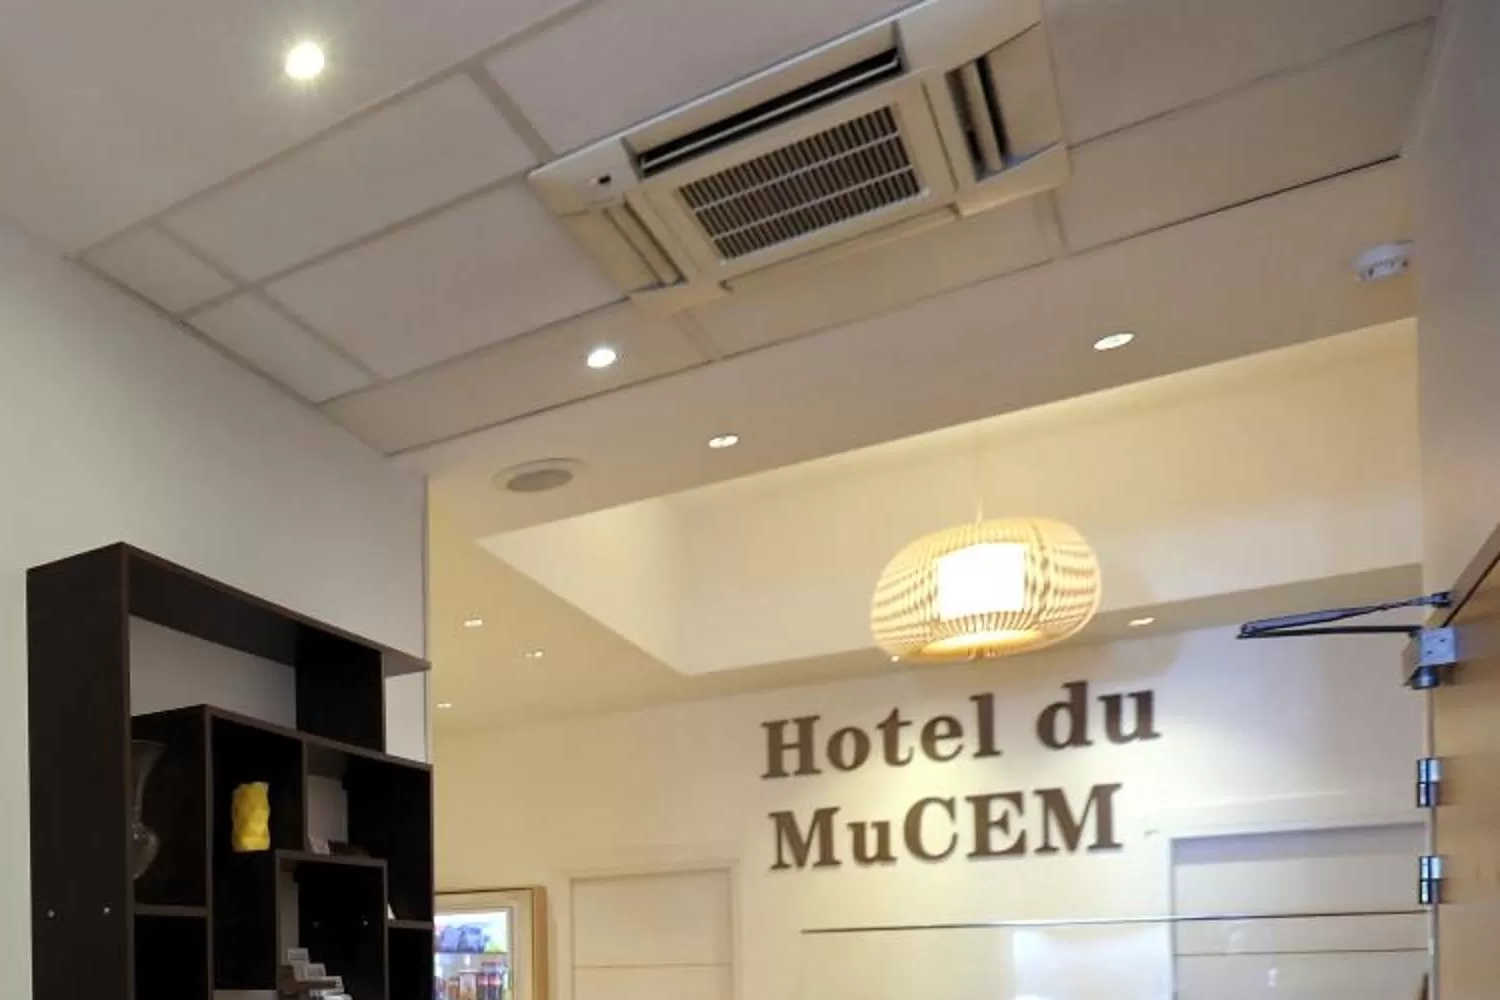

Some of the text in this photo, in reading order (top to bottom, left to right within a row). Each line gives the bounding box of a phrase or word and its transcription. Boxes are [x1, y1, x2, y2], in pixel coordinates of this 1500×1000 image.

[760, 680, 1162, 780] Hotel du
[768, 782, 1125, 872] MuCEM
